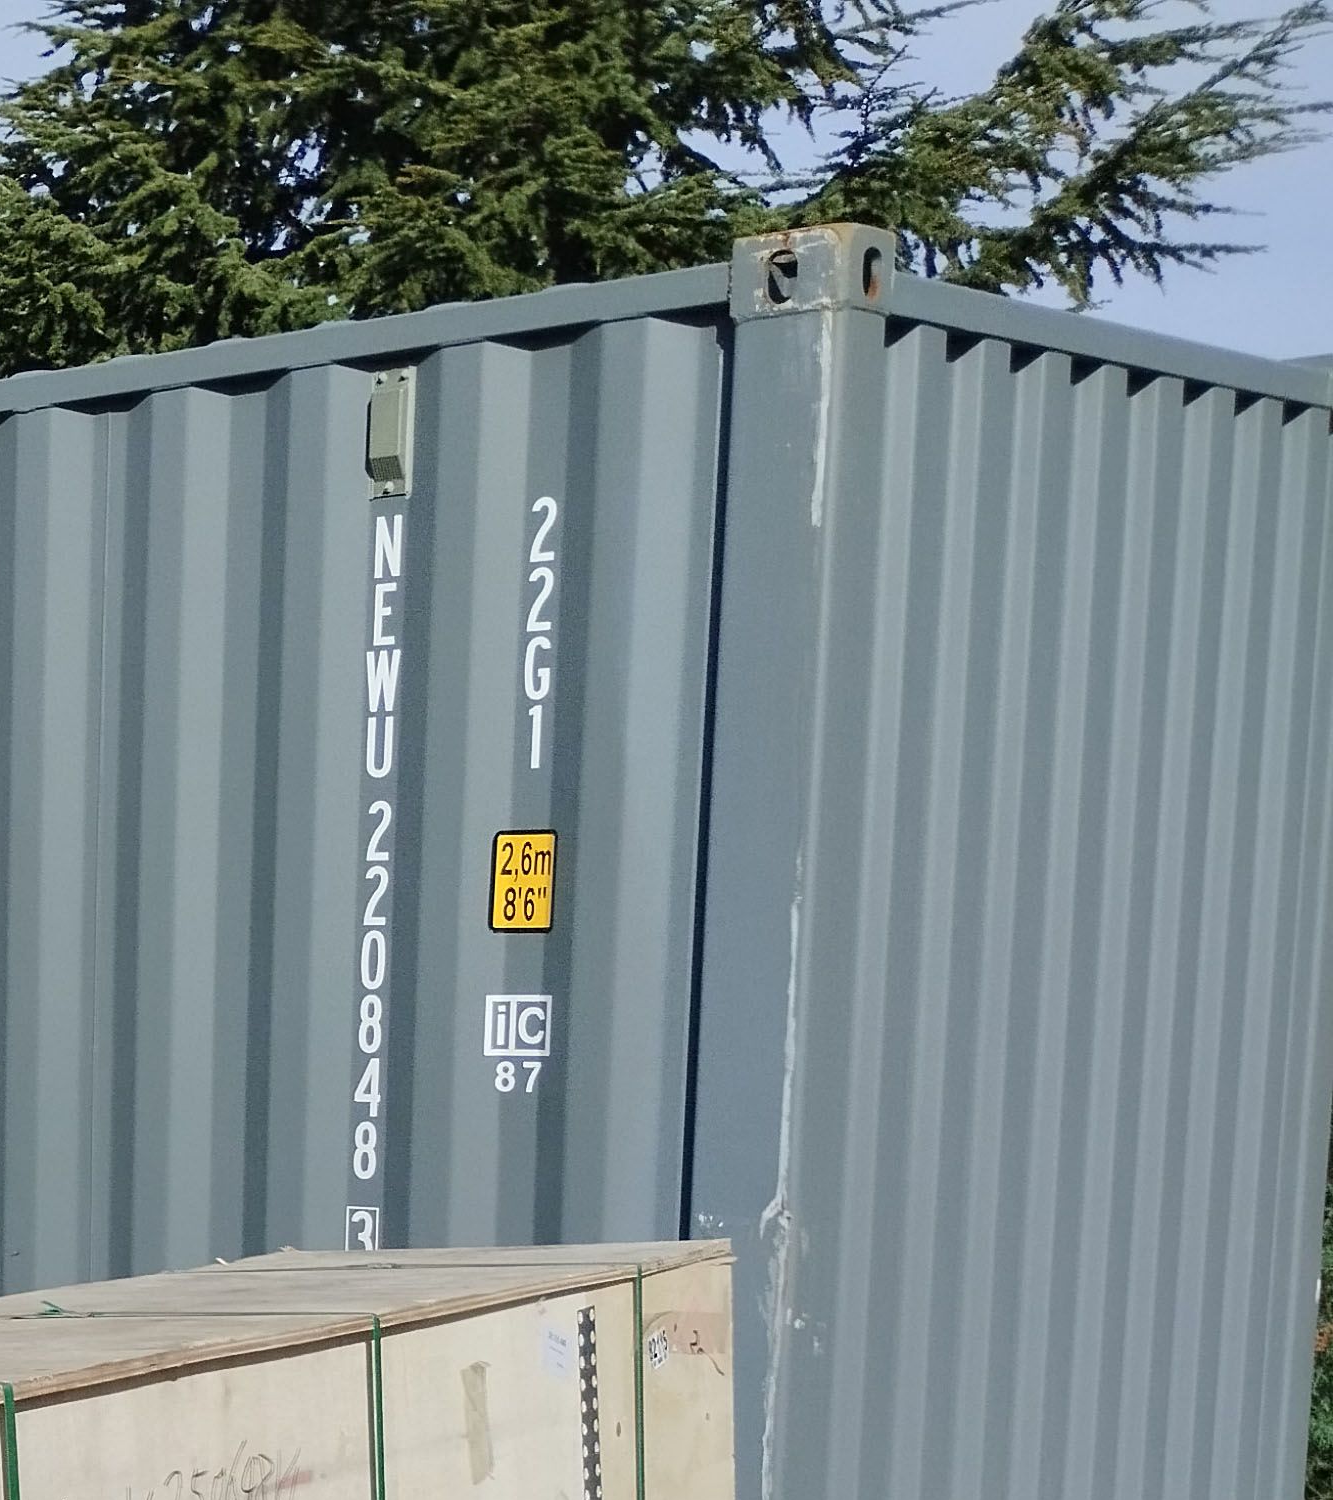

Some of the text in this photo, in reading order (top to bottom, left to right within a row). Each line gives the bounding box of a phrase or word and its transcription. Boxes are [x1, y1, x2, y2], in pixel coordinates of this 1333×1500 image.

[523, 496, 558, 769] 22G1
[500, 841, 552, 882] 2,6m
[351, 514, 403, 1251] NEWU 220848 3
[503, 886, 548, 922] 8'6"
[494, 1060, 542, 1093] 87
